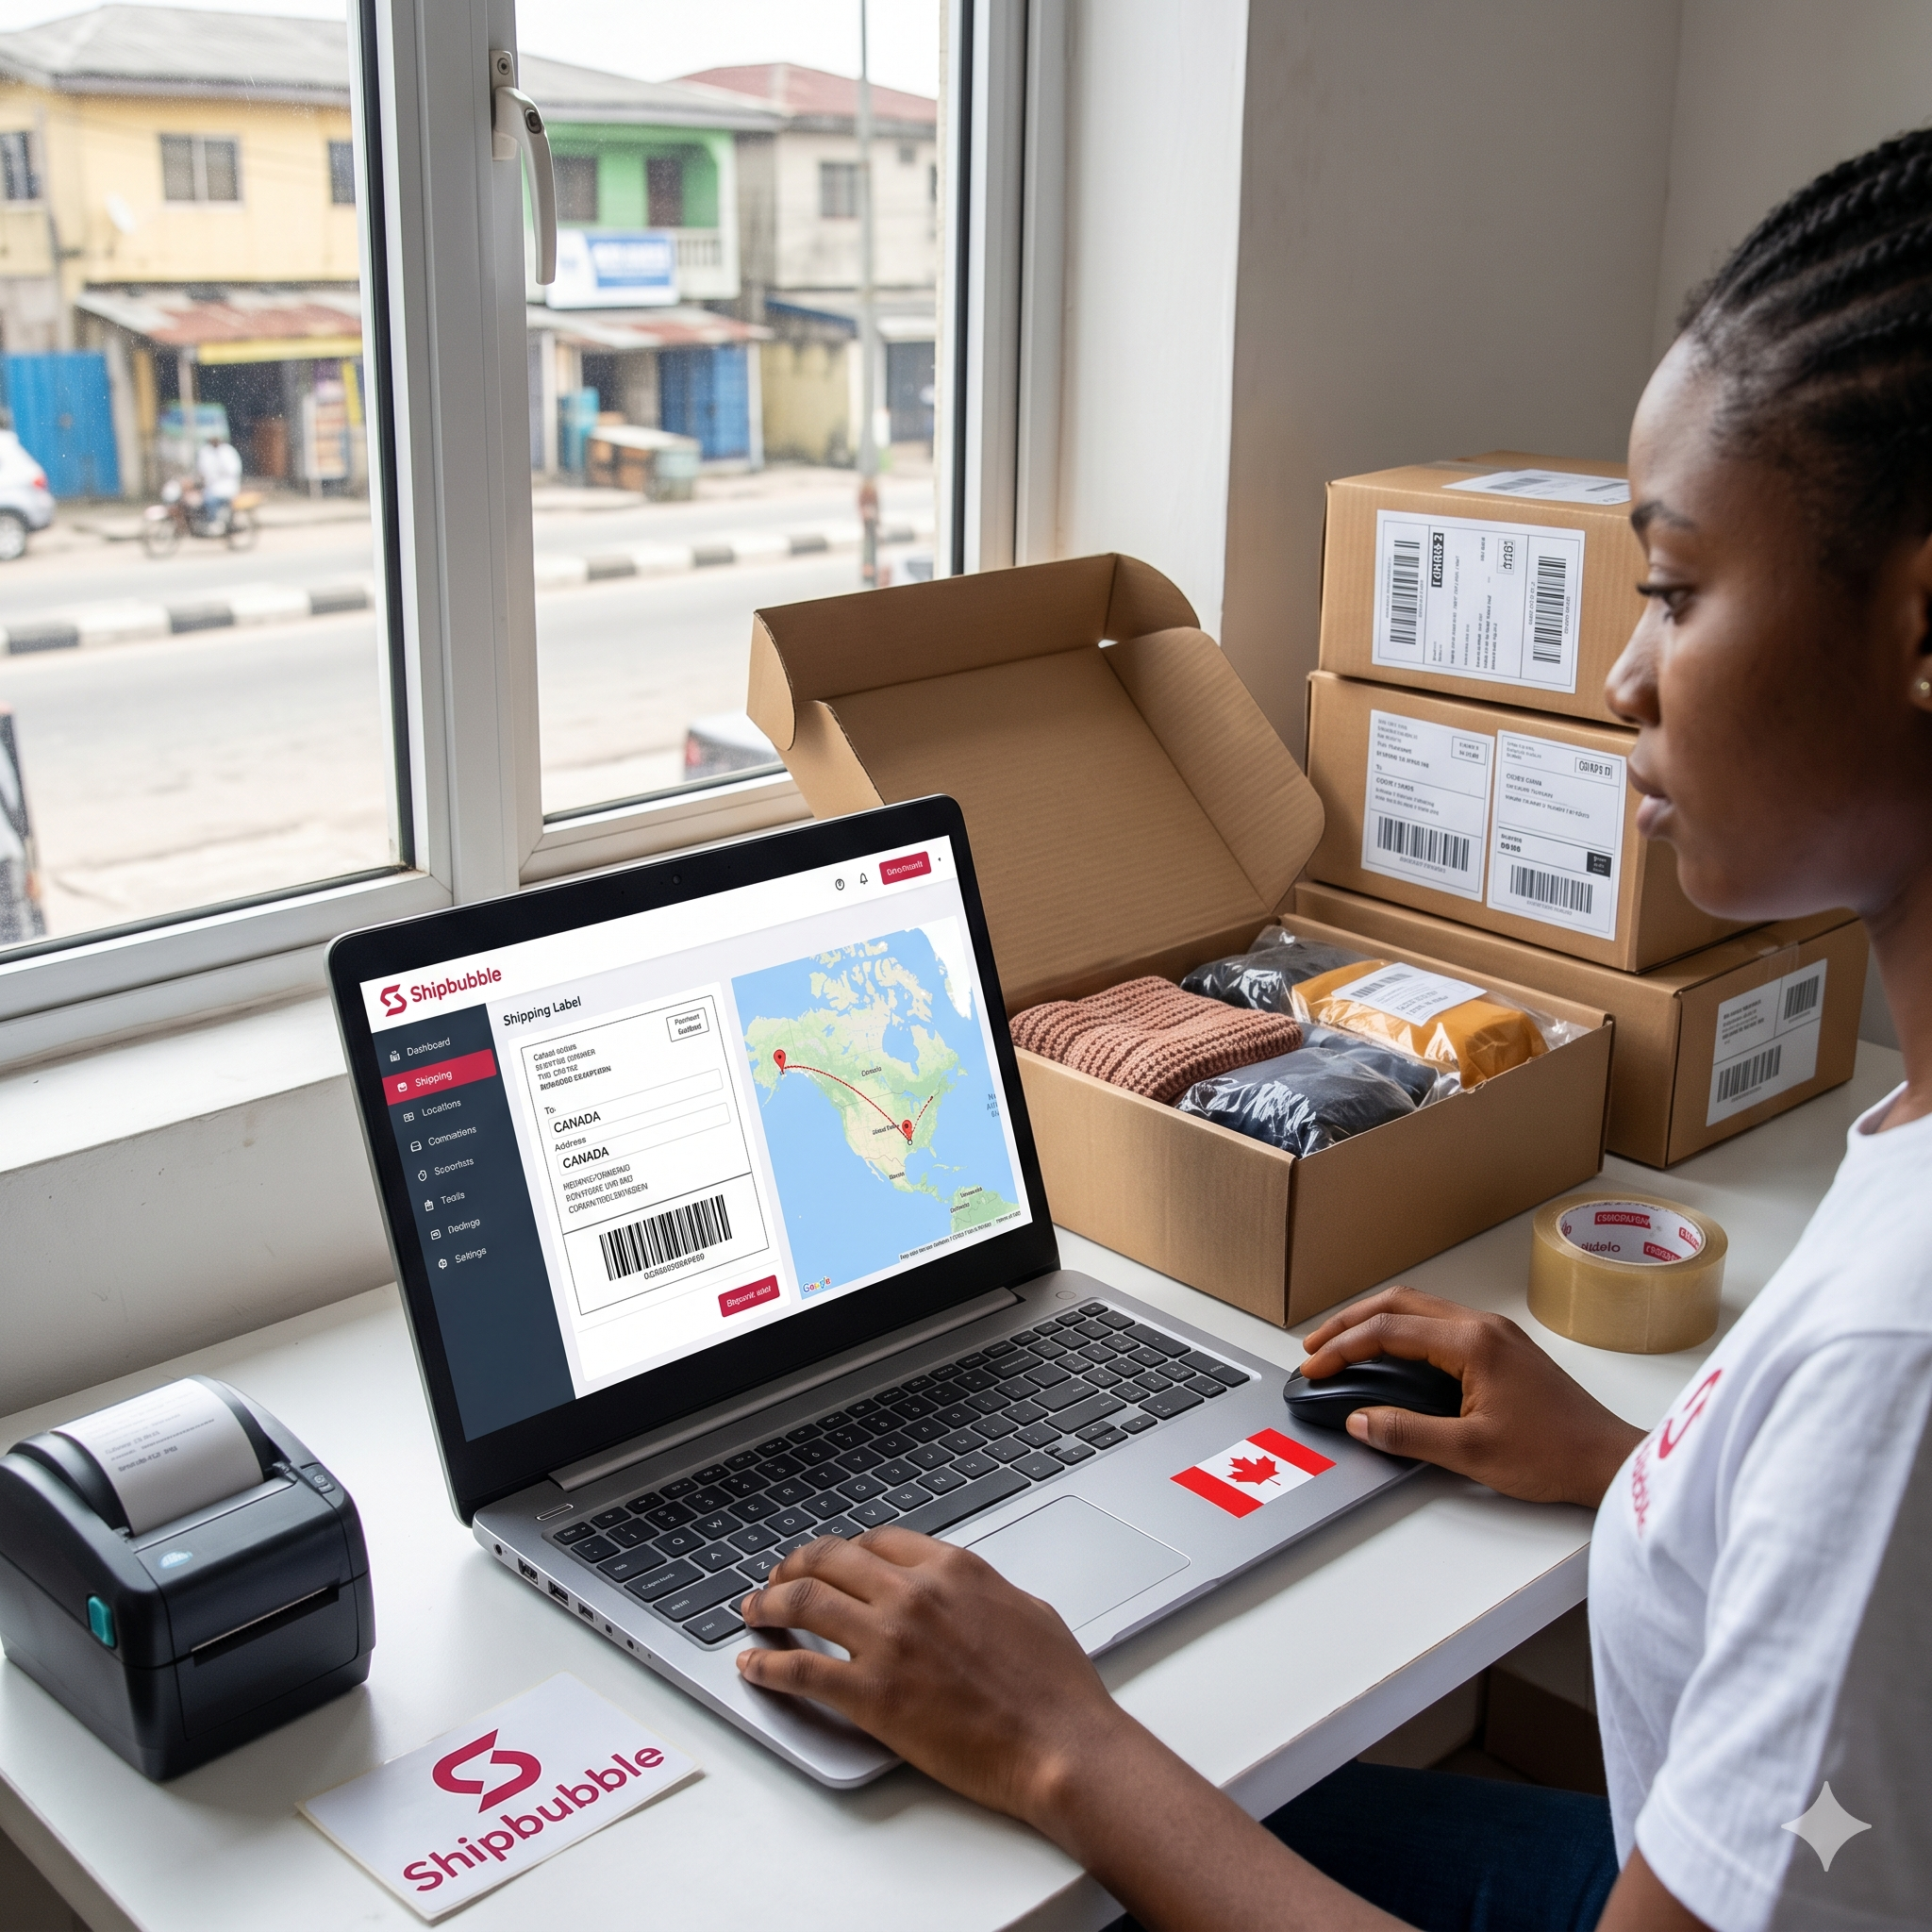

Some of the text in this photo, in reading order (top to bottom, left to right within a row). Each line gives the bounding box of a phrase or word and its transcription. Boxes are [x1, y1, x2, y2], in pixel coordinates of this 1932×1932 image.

[410, 967, 502, 1003] Shipbubble
[503, 996, 582, 1027] Shipping Label
[415, 1071, 453, 1088] Shipping
[422, 1100, 461, 1117] Locations
[554, 1110, 601, 1133] CANADA
[555, 1136, 587, 1152] Address
[562, 1146, 609, 1169] CANADA
[402, 1746, 665, 1891] Shipbubble
